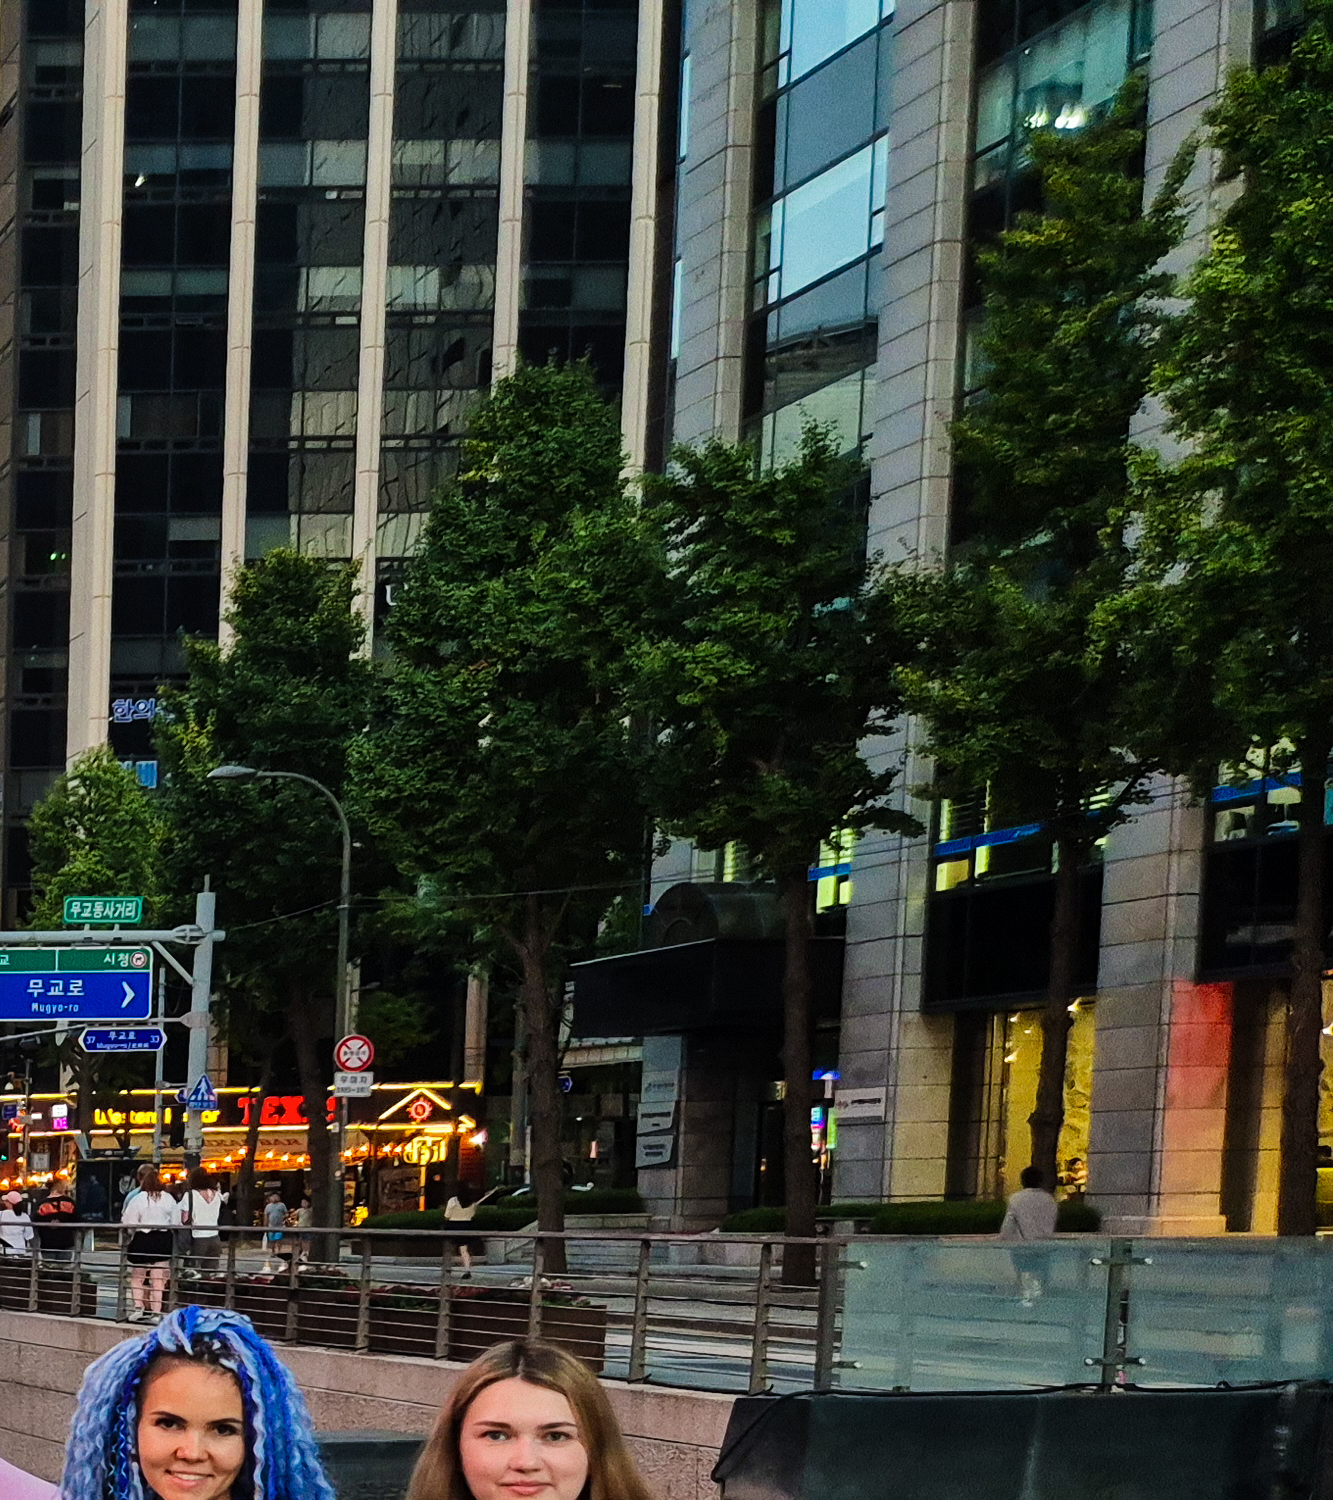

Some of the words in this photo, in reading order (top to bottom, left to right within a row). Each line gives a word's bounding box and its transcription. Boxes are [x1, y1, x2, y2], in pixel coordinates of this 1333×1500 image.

[112, 698, 163, 723] 한의
[70, 901, 137, 918] 무교동사거리
[103, 953, 130, 968] 시청
[26, 979, 85, 998] 무교로
[31, 1002, 79, 1015] Mugyo-ro
[237, 1095, 336, 1125] TEXS
